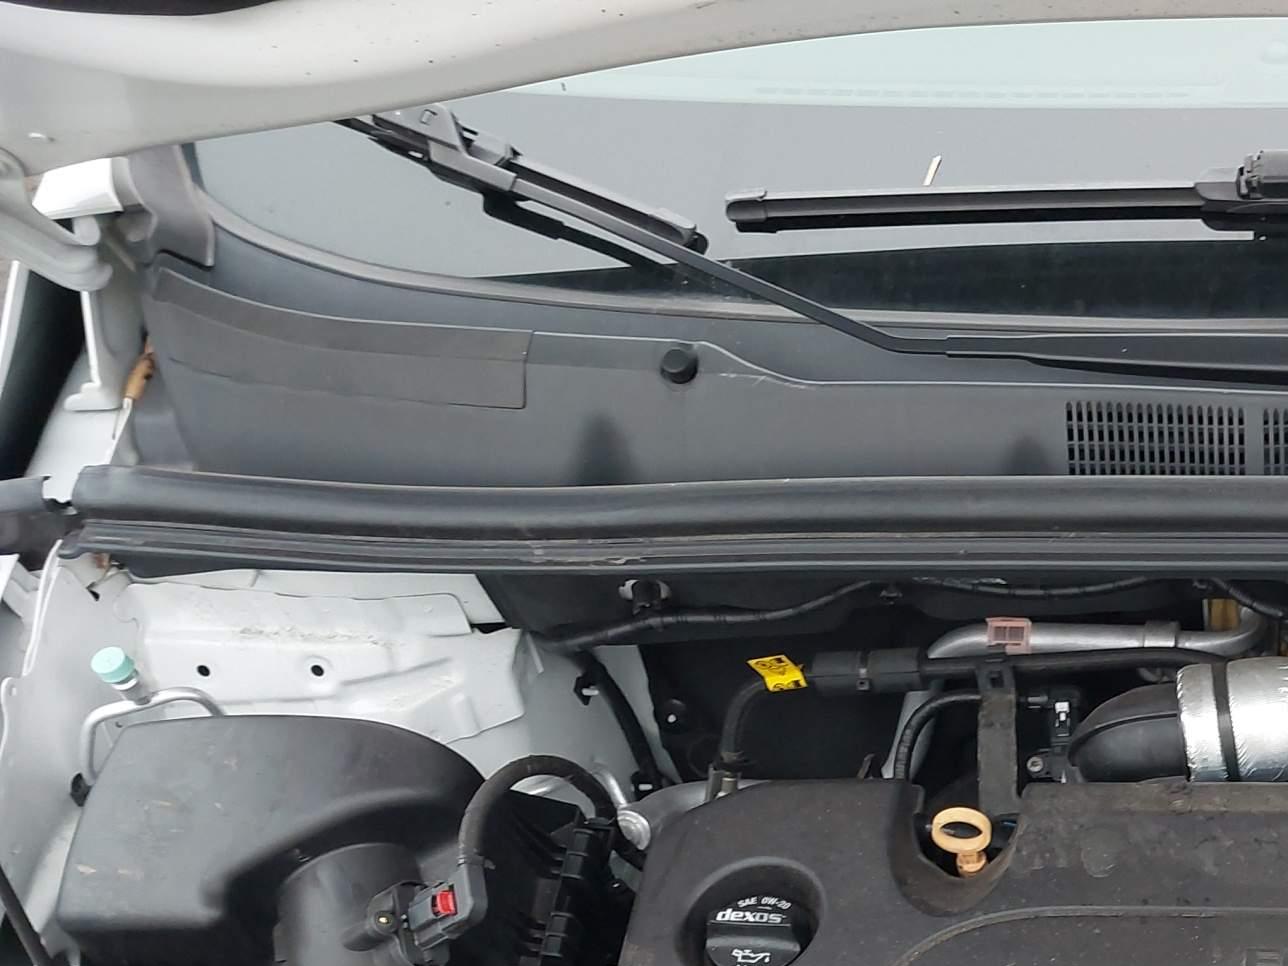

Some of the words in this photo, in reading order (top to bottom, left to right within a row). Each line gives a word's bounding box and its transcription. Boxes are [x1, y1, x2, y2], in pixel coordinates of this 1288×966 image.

[737, 897, 758, 908] SAE
[760, 896, 792, 910] 0W-20
[716, 908, 784, 924] dexos
